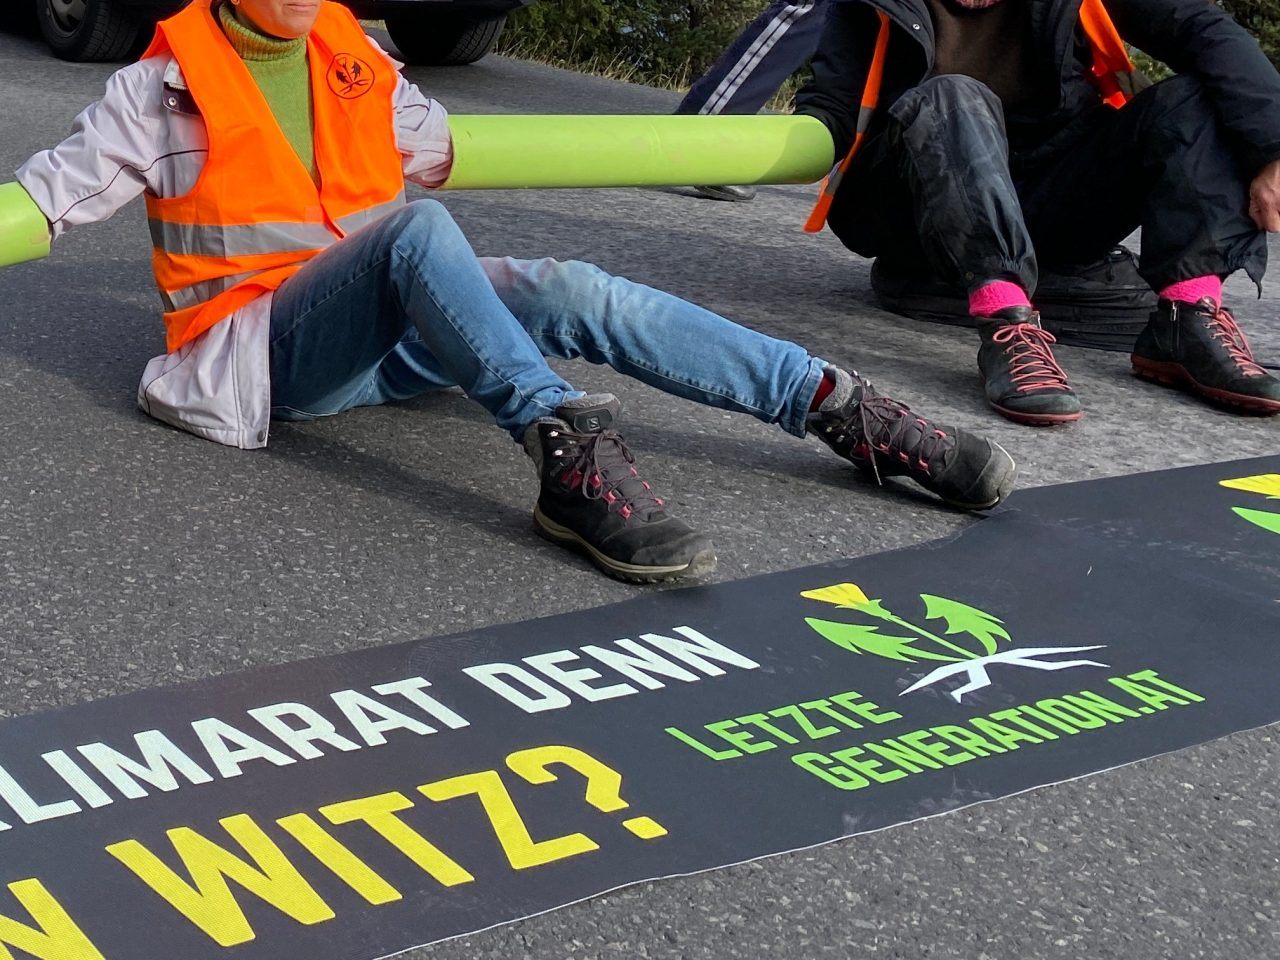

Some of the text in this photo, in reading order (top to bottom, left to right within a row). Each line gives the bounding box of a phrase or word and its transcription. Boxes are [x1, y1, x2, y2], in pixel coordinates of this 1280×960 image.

[463, 625, 761, 714] DENN
[665, 691, 904, 761] LETZTE
[791, 669, 1206, 791] GENERATION.AT
[106, 745, 668, 947] WITZ?
